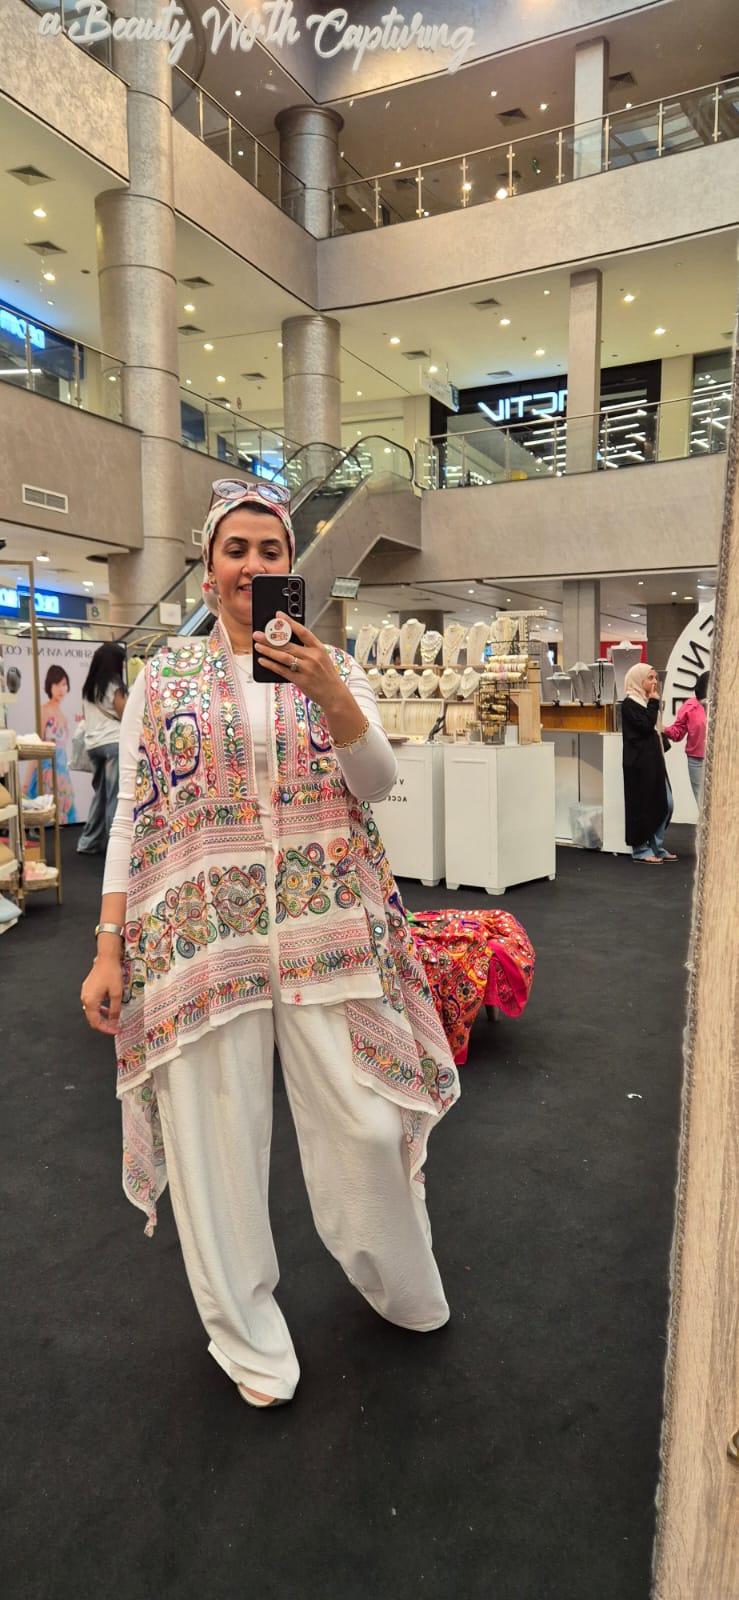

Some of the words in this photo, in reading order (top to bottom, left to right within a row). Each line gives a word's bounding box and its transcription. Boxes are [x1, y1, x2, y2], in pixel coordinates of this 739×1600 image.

[38, 11, 63, 37] a
[64, 1, 194, 66] Beauty
[305, 7, 476, 75] Capturing
